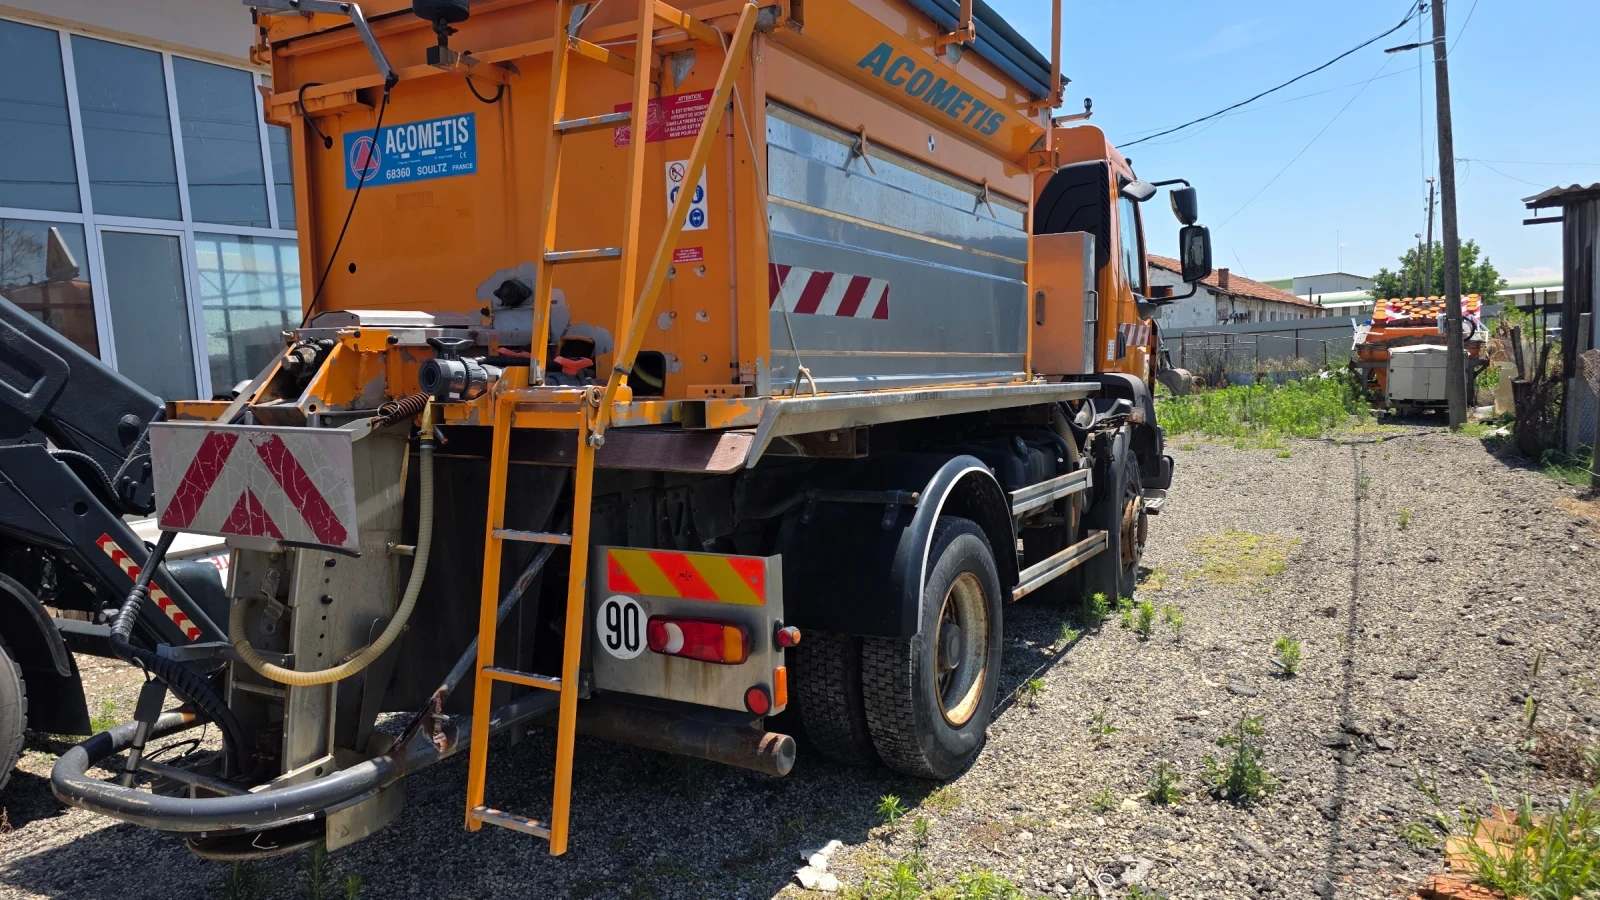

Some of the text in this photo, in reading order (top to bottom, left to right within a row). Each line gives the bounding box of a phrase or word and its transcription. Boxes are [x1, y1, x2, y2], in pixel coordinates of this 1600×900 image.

[678, 93, 701, 101] ATTENTION
[857, 41, 1006, 136] ACOMETIS
[385, 116, 469, 155] ACOMETIS
[386, 163, 473, 179] 68360 SOULTZ FRANCE
[606, 601, 640, 652] 90
